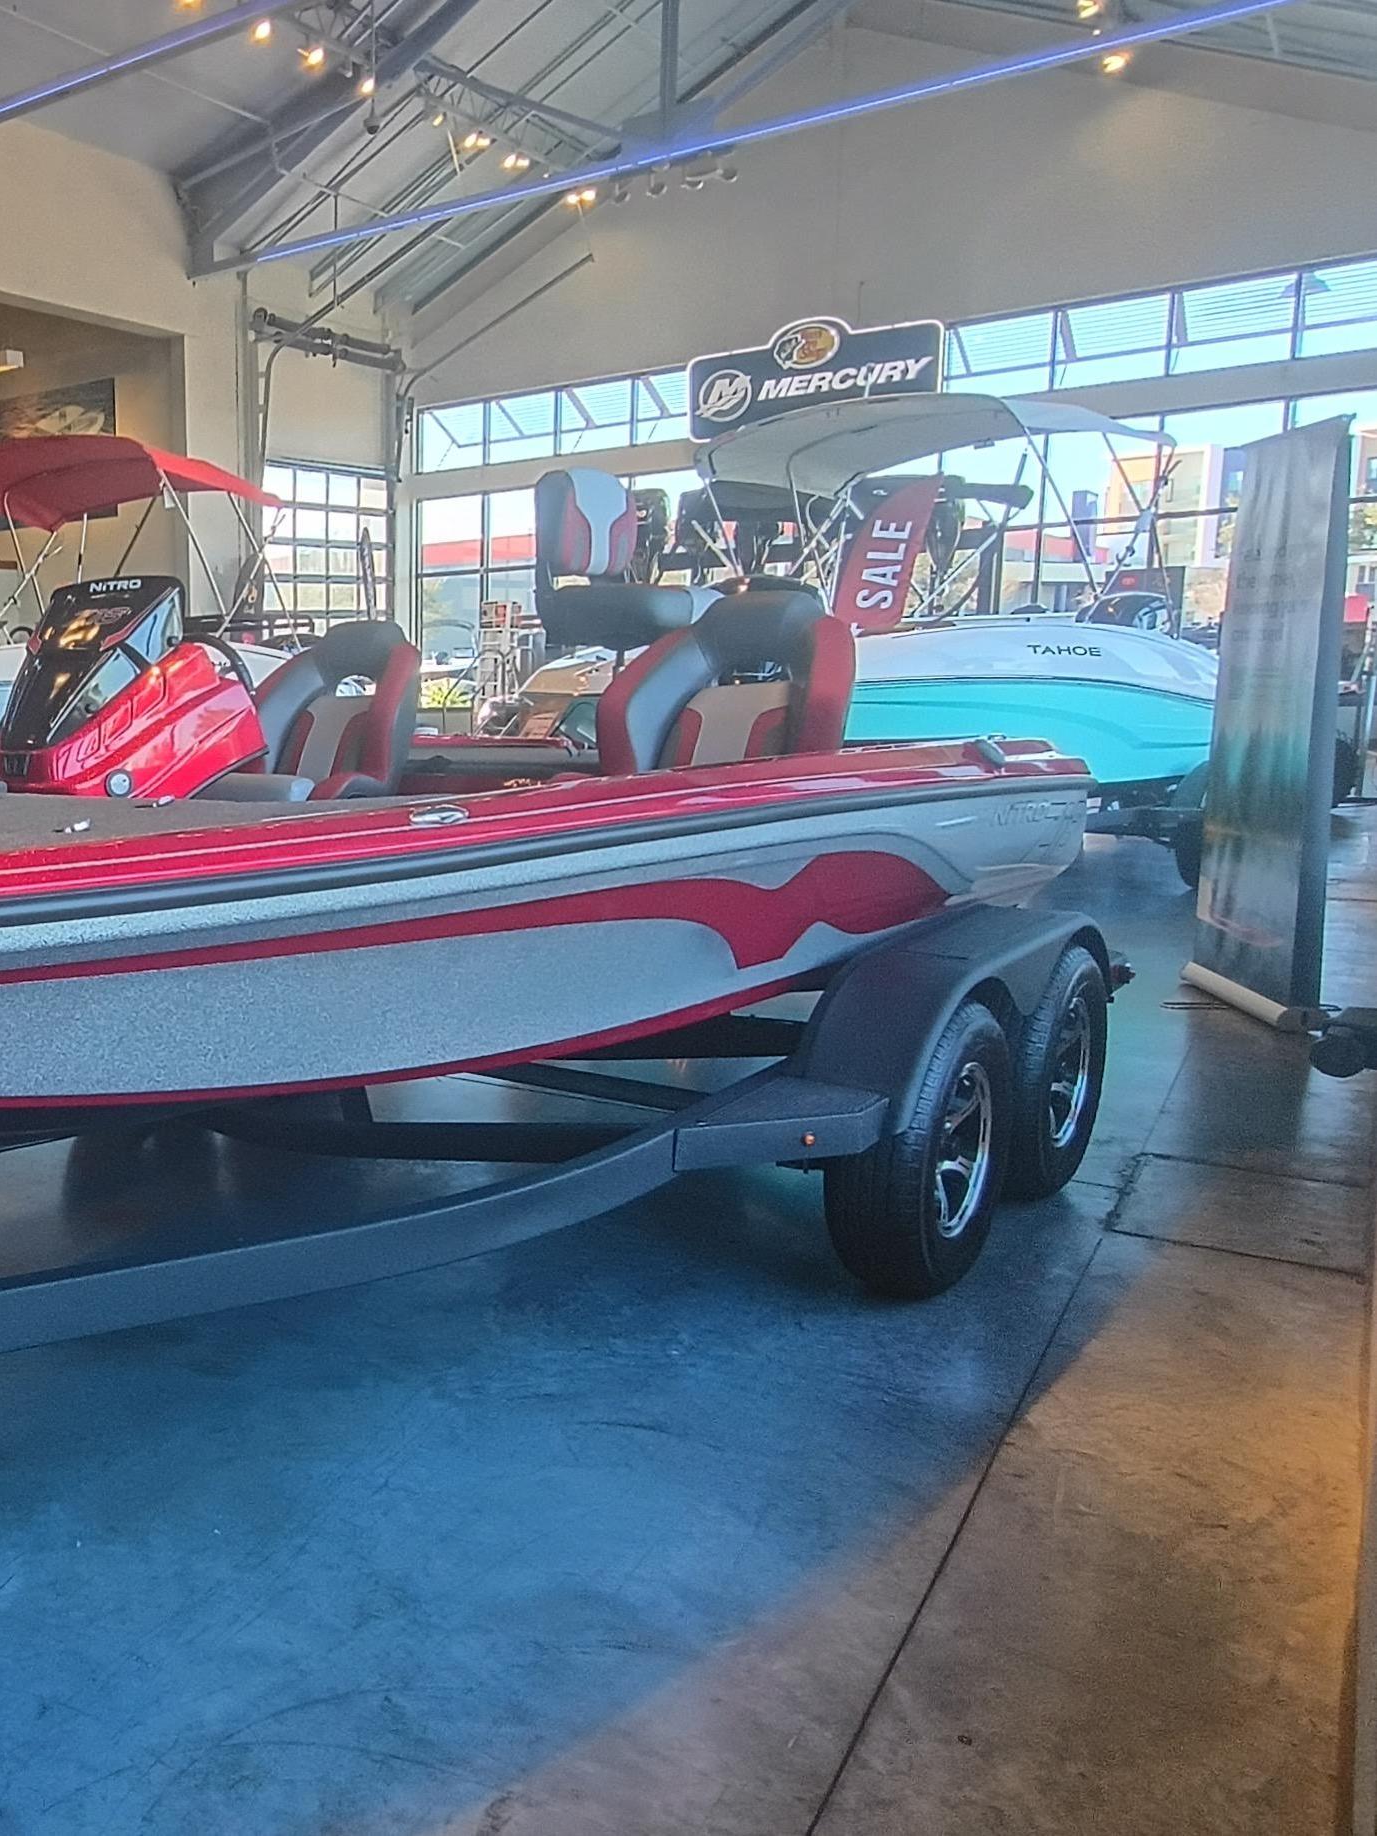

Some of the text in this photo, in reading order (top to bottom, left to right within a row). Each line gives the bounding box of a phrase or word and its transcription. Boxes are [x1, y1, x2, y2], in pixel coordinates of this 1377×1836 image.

[757, 356, 934, 401] MERCURY
[855, 519, 913, 610] SALE
[1026, 644, 1102, 657] TAHOE
